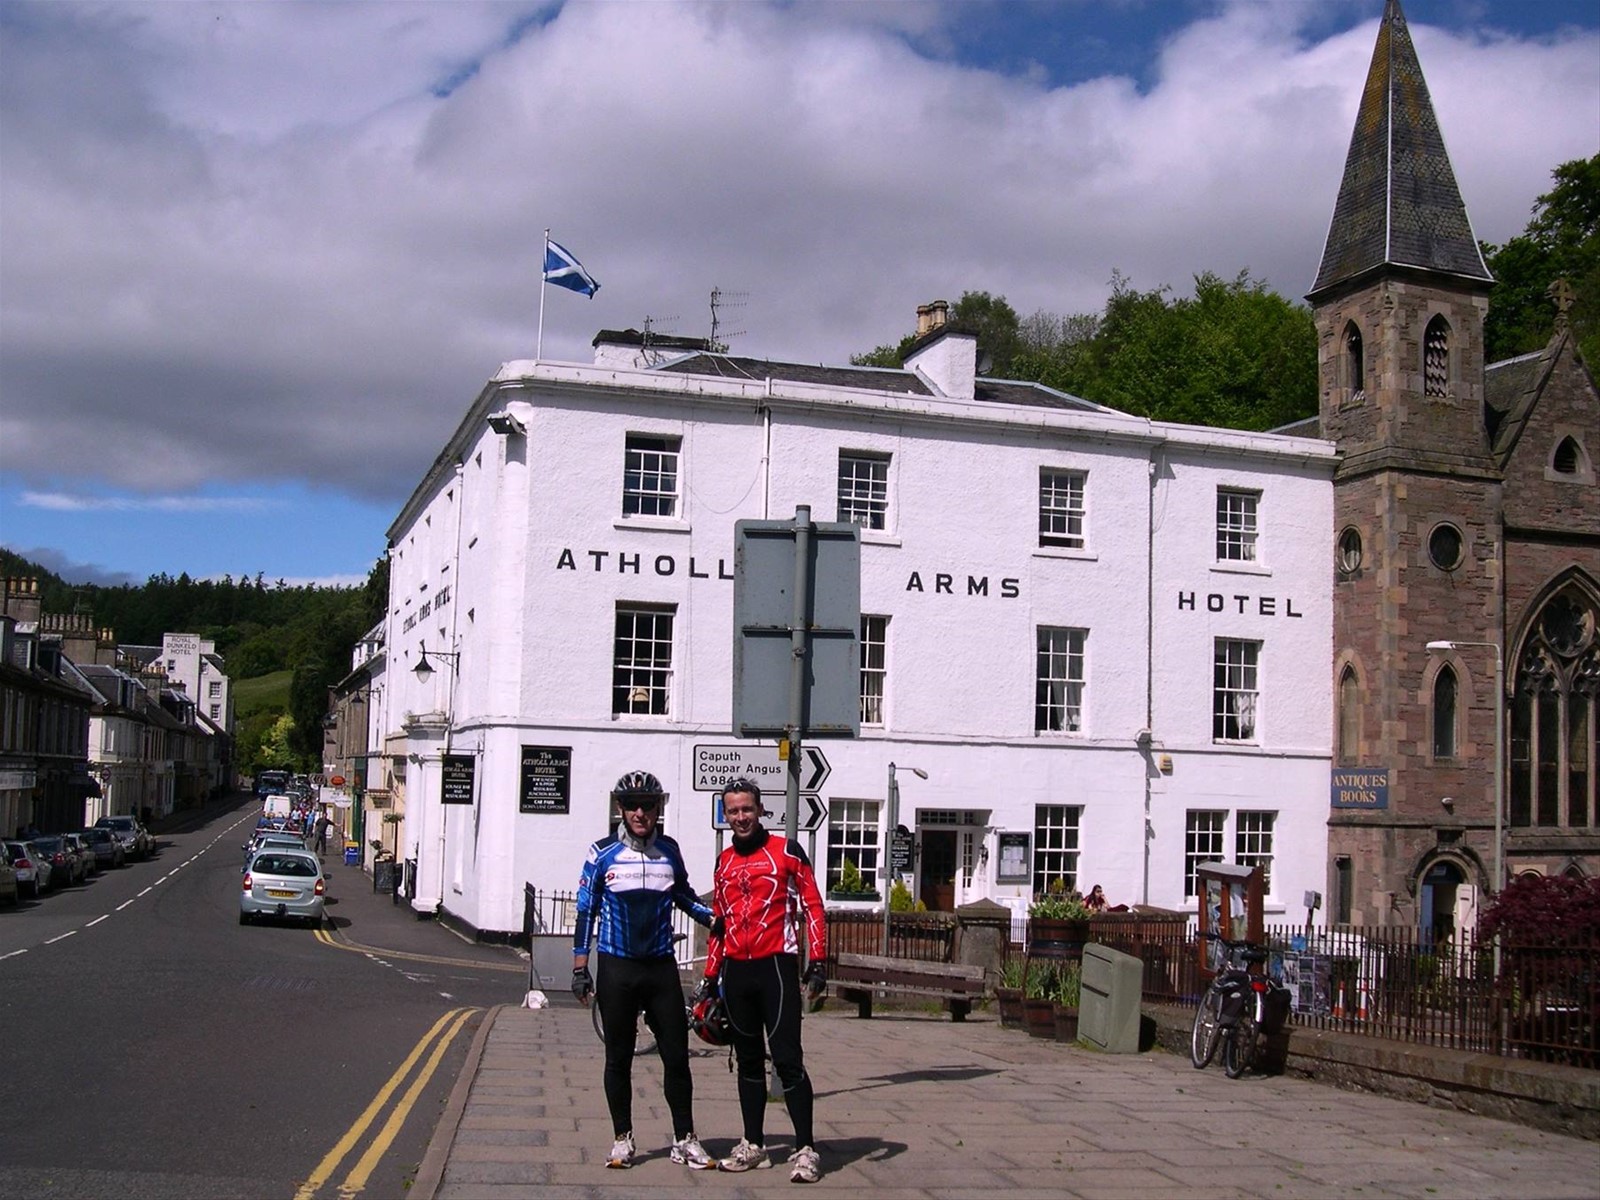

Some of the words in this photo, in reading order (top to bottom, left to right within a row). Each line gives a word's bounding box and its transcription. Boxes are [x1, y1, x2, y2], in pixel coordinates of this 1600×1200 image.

[556, 548, 735, 580] ATHOLL
[906, 571, 1020, 598] ARMS
[1178, 591, 1303, 618] HOTEL
[166, 642, 197, 650] DUNKELD
[699, 751, 741, 762] Caputh
[699, 763, 740, 774] Coupar
[745, 764, 782, 775] Angus
[1332, 774, 1387, 790] ANTIQUES
[1340, 790, 1377, 803] BOOKS
